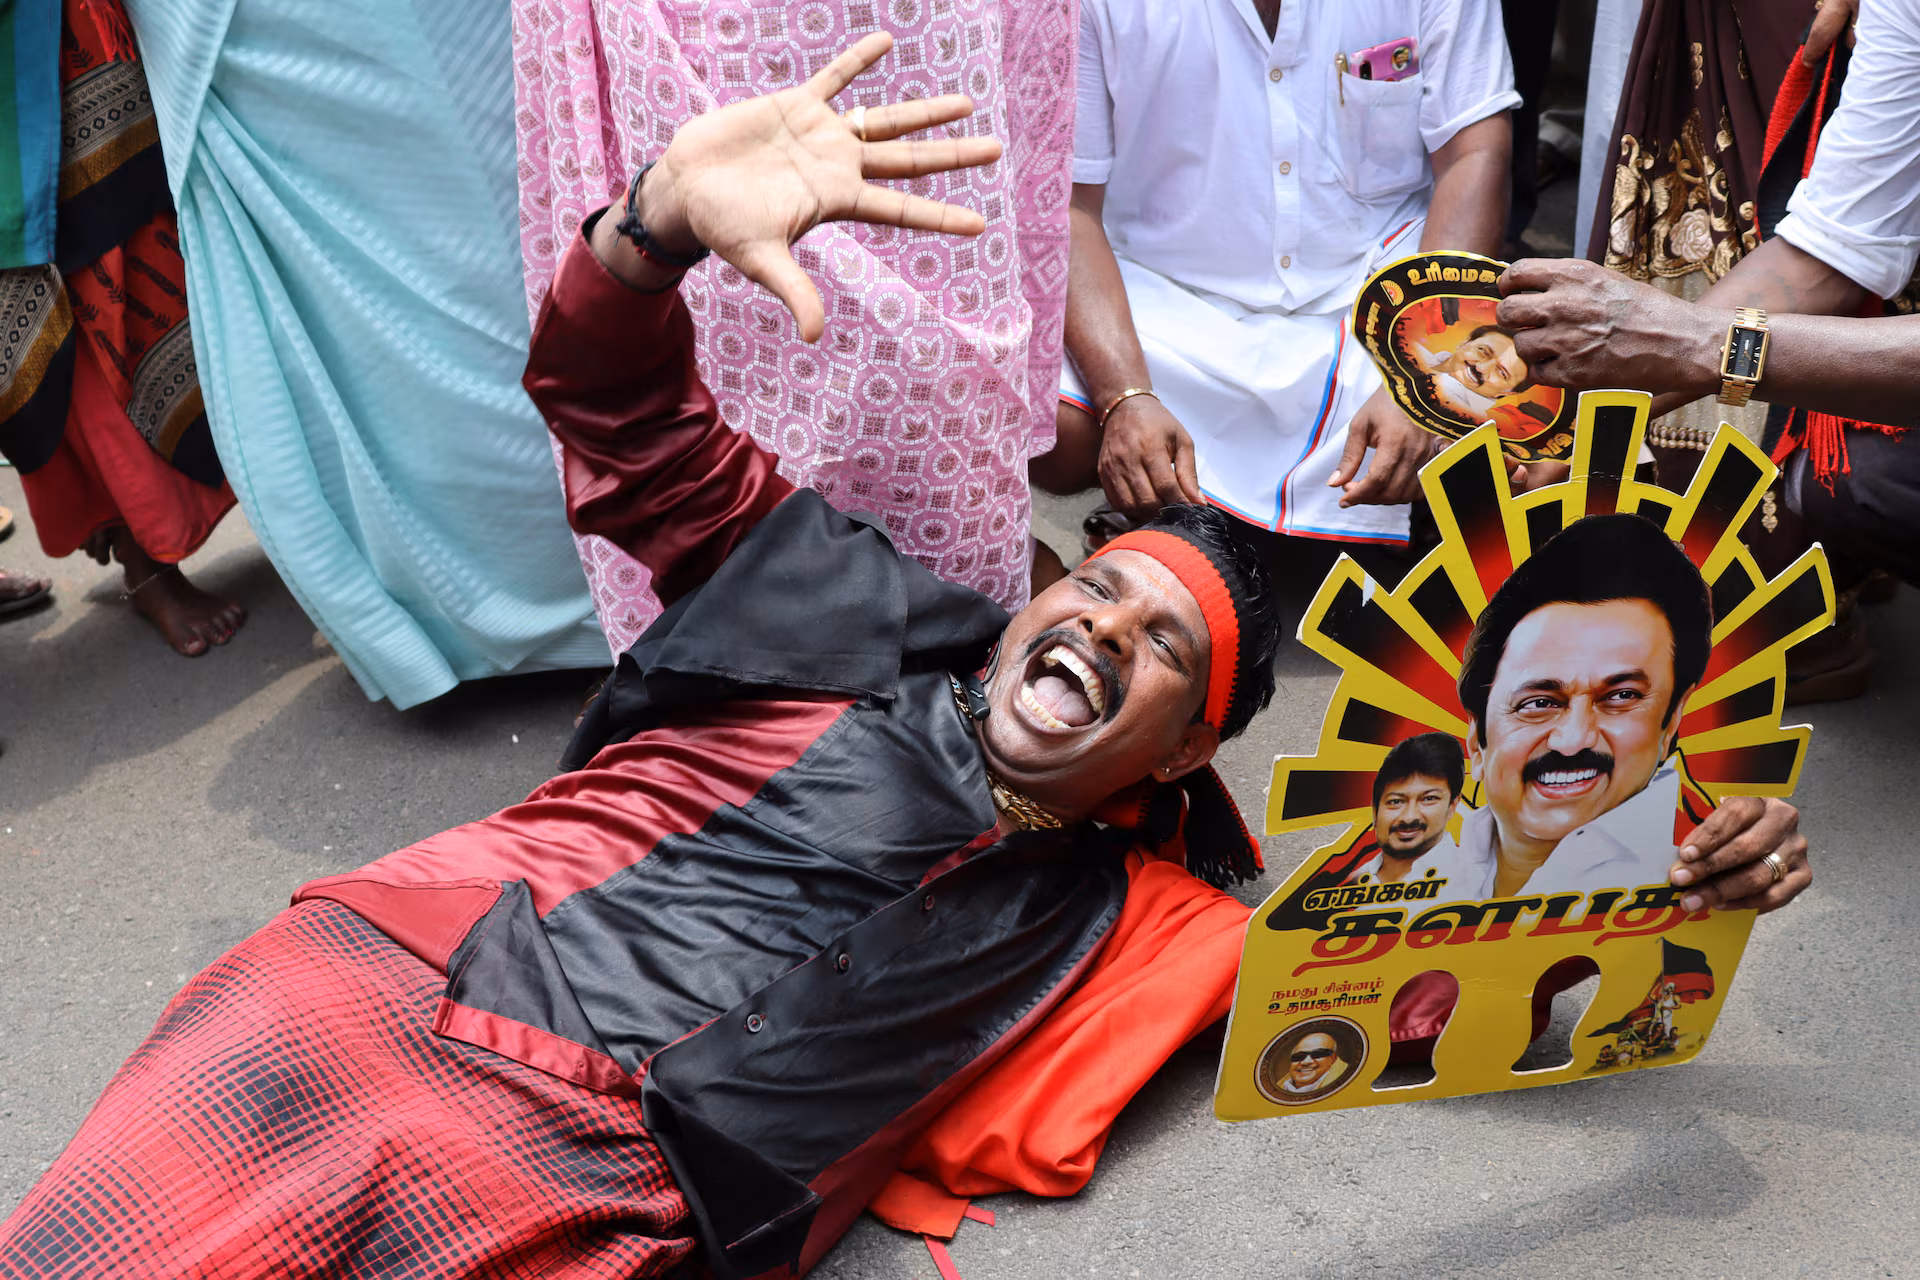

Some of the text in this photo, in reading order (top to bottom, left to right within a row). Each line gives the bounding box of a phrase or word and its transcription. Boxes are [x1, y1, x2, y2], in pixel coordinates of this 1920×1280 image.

[1407, 261, 1501, 286] உரிமைக
[1303, 867, 1448, 909] எங்கள்
[1267, 988, 1382, 1016] உதயசூரியன்
[1270, 976, 1385, 1002] நமது சின்னம்
